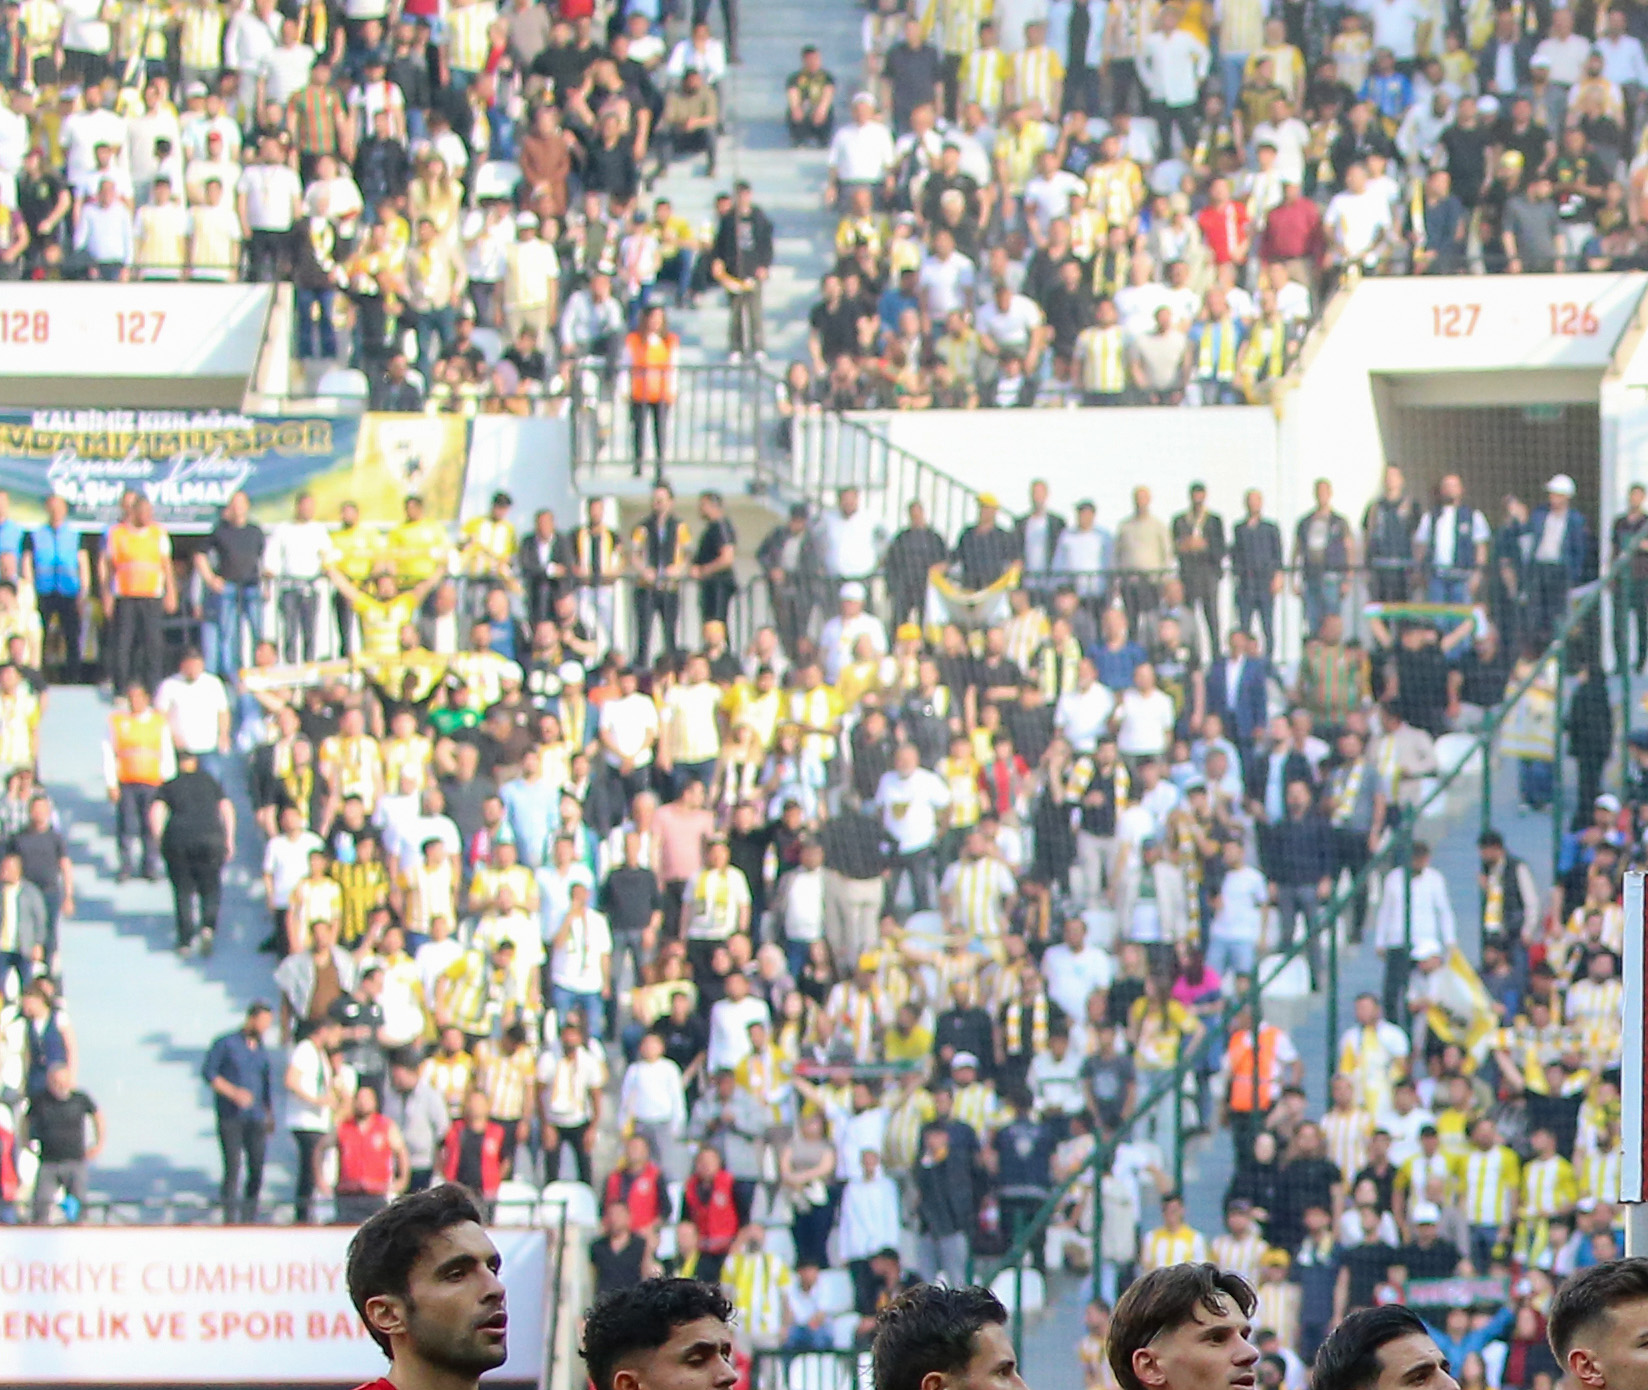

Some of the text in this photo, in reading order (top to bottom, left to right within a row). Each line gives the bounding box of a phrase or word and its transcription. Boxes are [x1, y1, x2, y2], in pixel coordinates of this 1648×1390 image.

[0, 309, 50, 344] 128
[115, 309, 167, 344] 127
[1432, 303, 1482, 338] 127
[1548, 301, 1600, 336] 126
[1, 1257, 344, 1294] ÜRKİYE CUMHURİY
[2, 1305, 131, 1349] ENÇLİK
[142, 1311, 188, 1342] VE
[199, 1311, 294, 1341] SPOR
